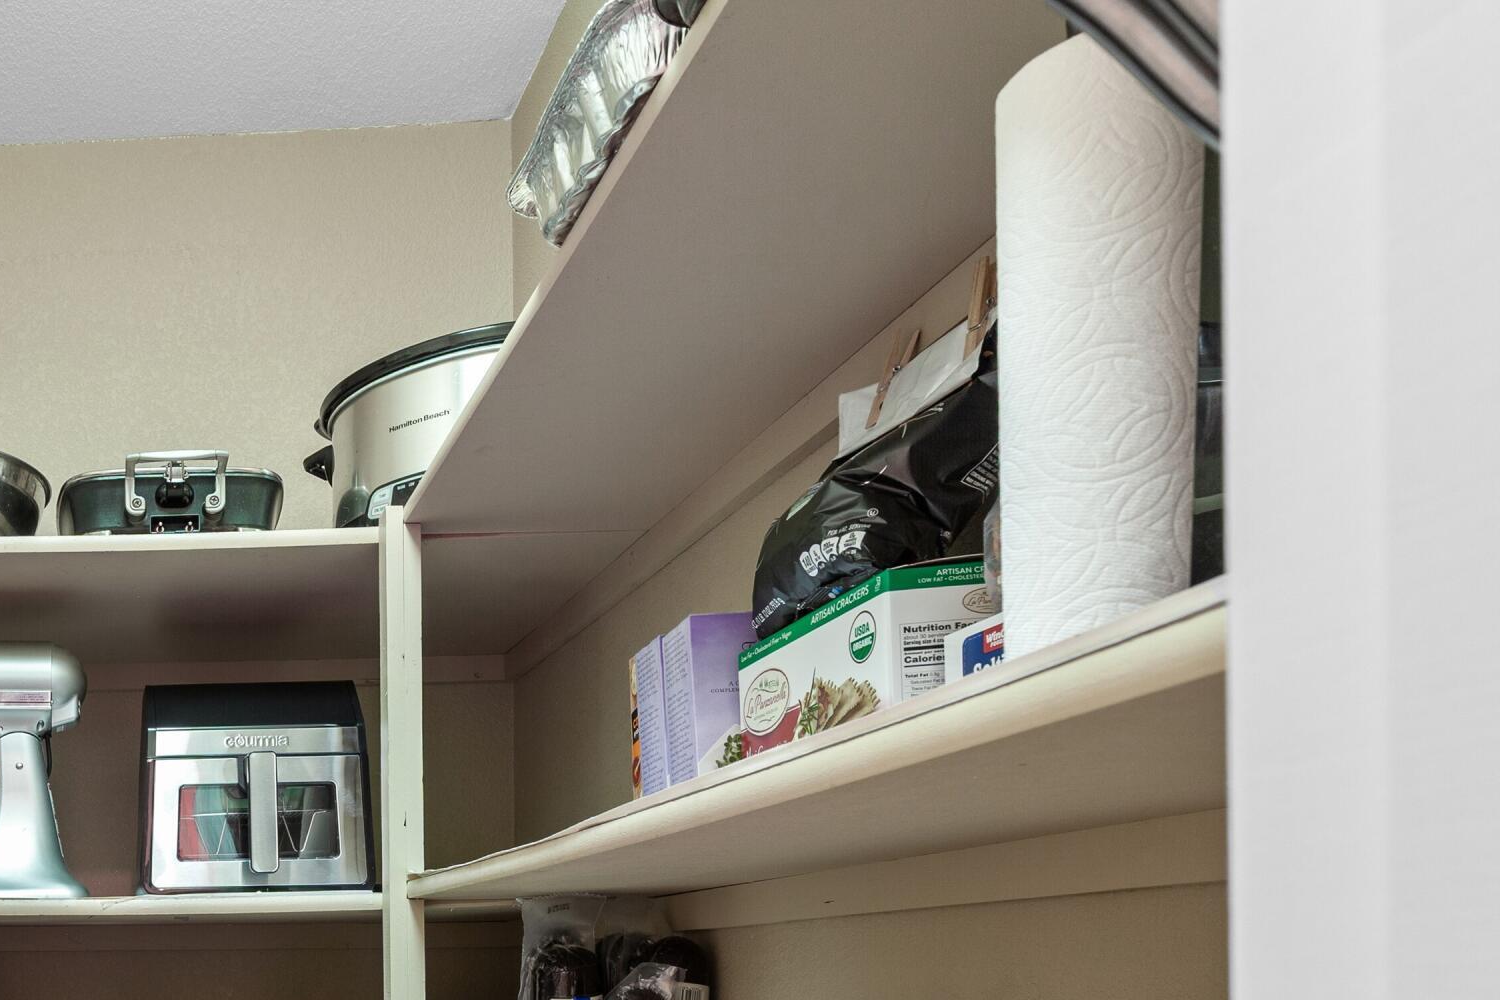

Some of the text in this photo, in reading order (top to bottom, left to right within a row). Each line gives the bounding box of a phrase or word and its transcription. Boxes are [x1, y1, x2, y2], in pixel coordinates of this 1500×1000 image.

[388, 409, 450, 433] Hamilton Beach
[936, 566, 974, 577] ARTISAN
[917, 576, 934, 584] LOW
[809, 604, 837, 626] ARTISAN
[835, 584, 871, 612] CRACKERS
[854, 621, 871, 638] USDA
[902, 622, 952, 634] Nutrition
[852, 636, 873, 652] ORGANIC
[903, 639, 922, 647] Serving
